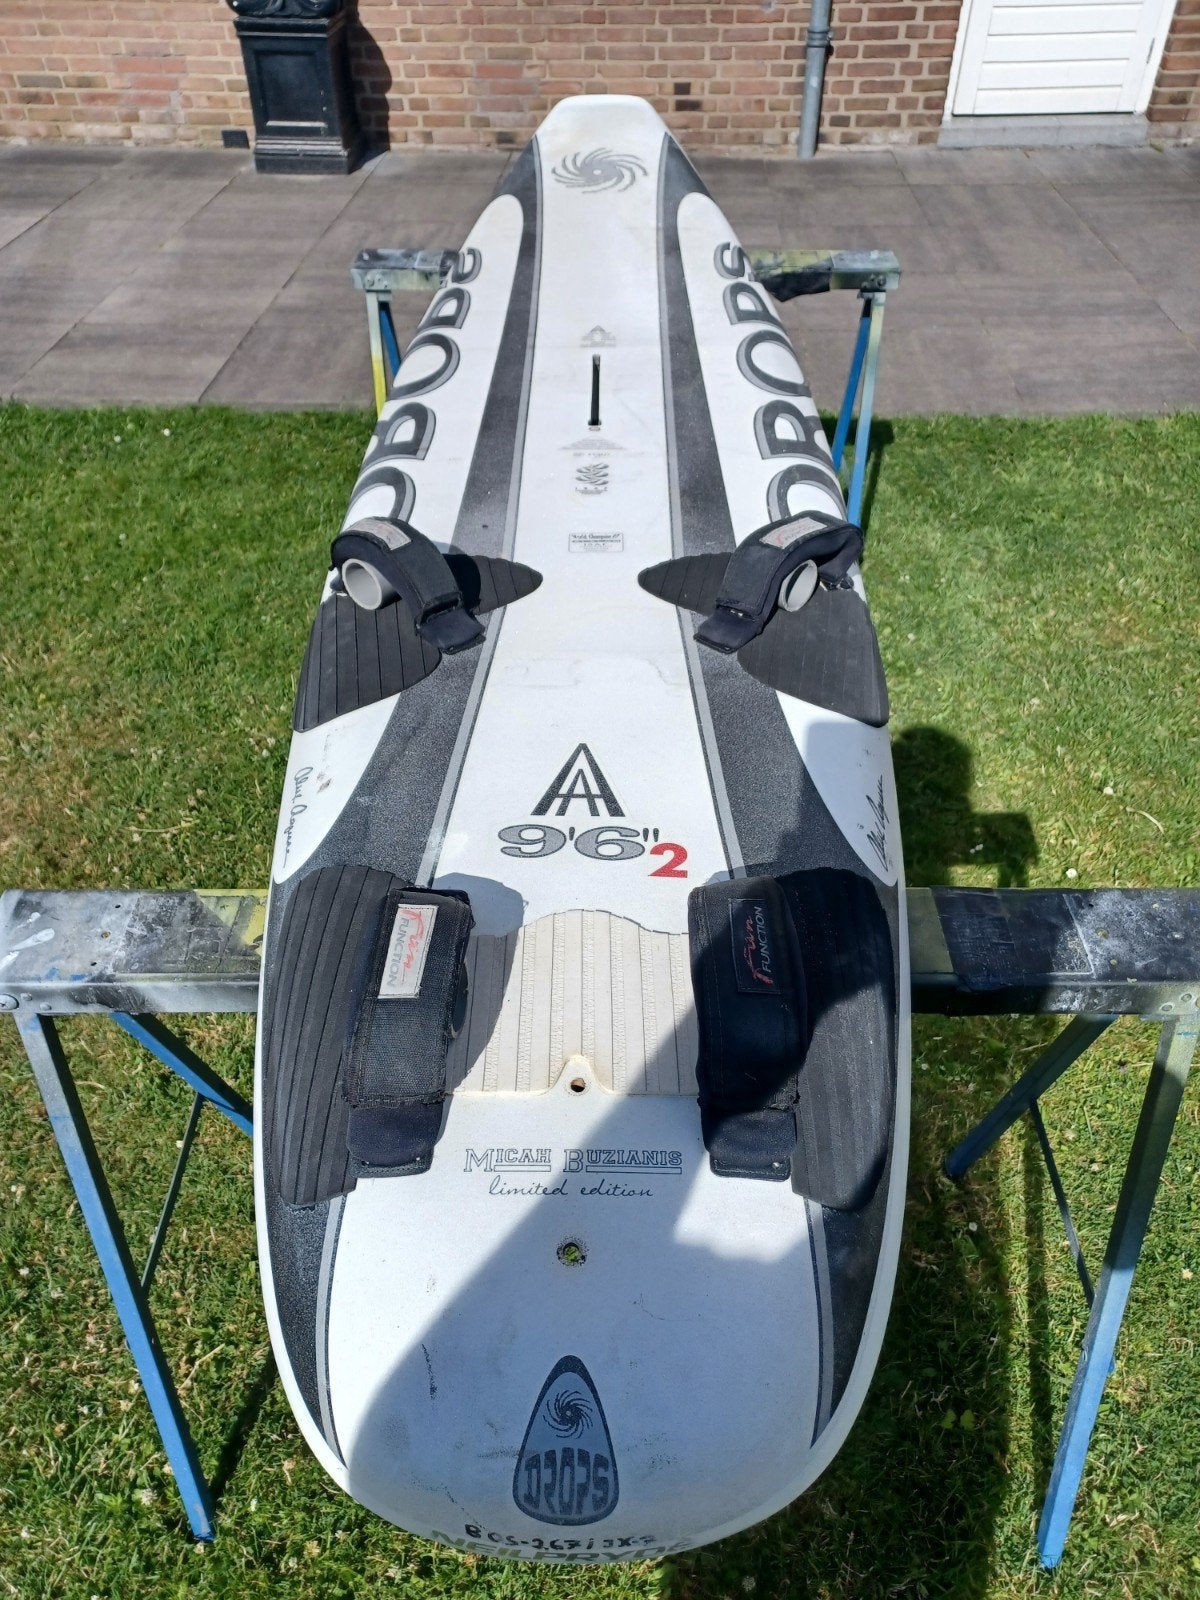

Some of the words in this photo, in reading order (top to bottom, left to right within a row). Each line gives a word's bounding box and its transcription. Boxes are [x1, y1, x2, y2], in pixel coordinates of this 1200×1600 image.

[753, 906, 772, 973] FUNCTION
[488, 1174, 568, 1196] limited
[580, 1178, 654, 1197] edition
[523, 1446, 610, 1516] DROPS
